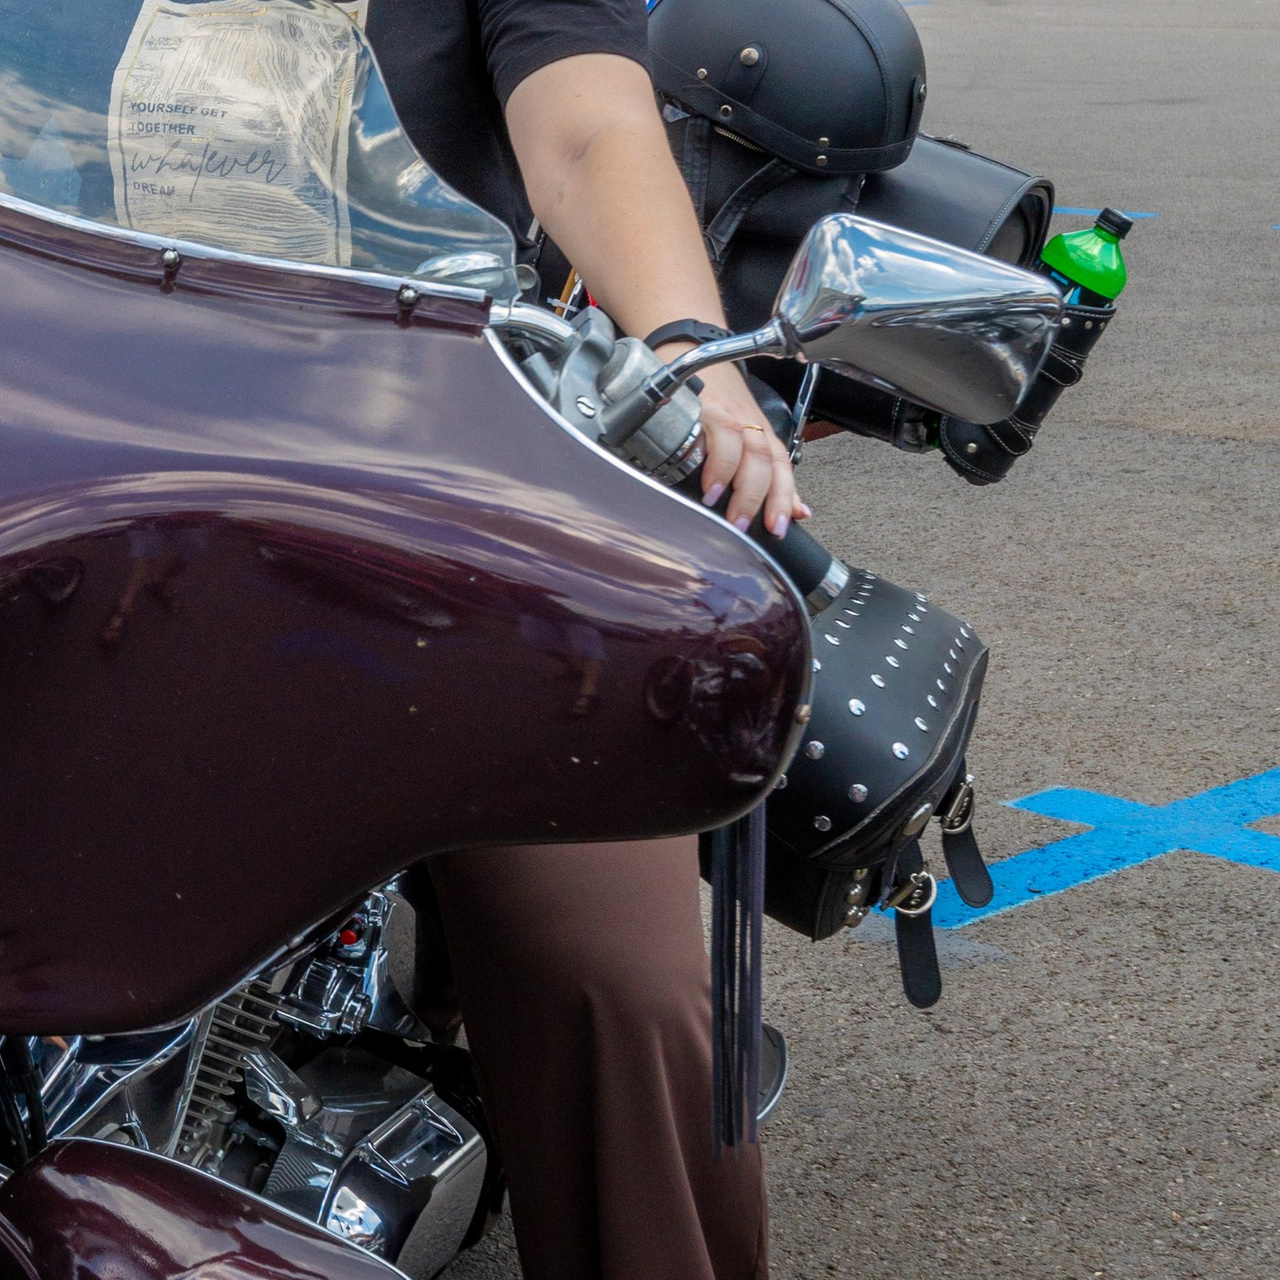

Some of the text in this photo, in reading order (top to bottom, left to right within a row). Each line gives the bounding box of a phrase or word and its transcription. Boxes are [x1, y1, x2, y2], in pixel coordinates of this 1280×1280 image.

[130, 102, 228, 118] YOURSELF GET
[129, 121, 196, 135] TOGETHER
